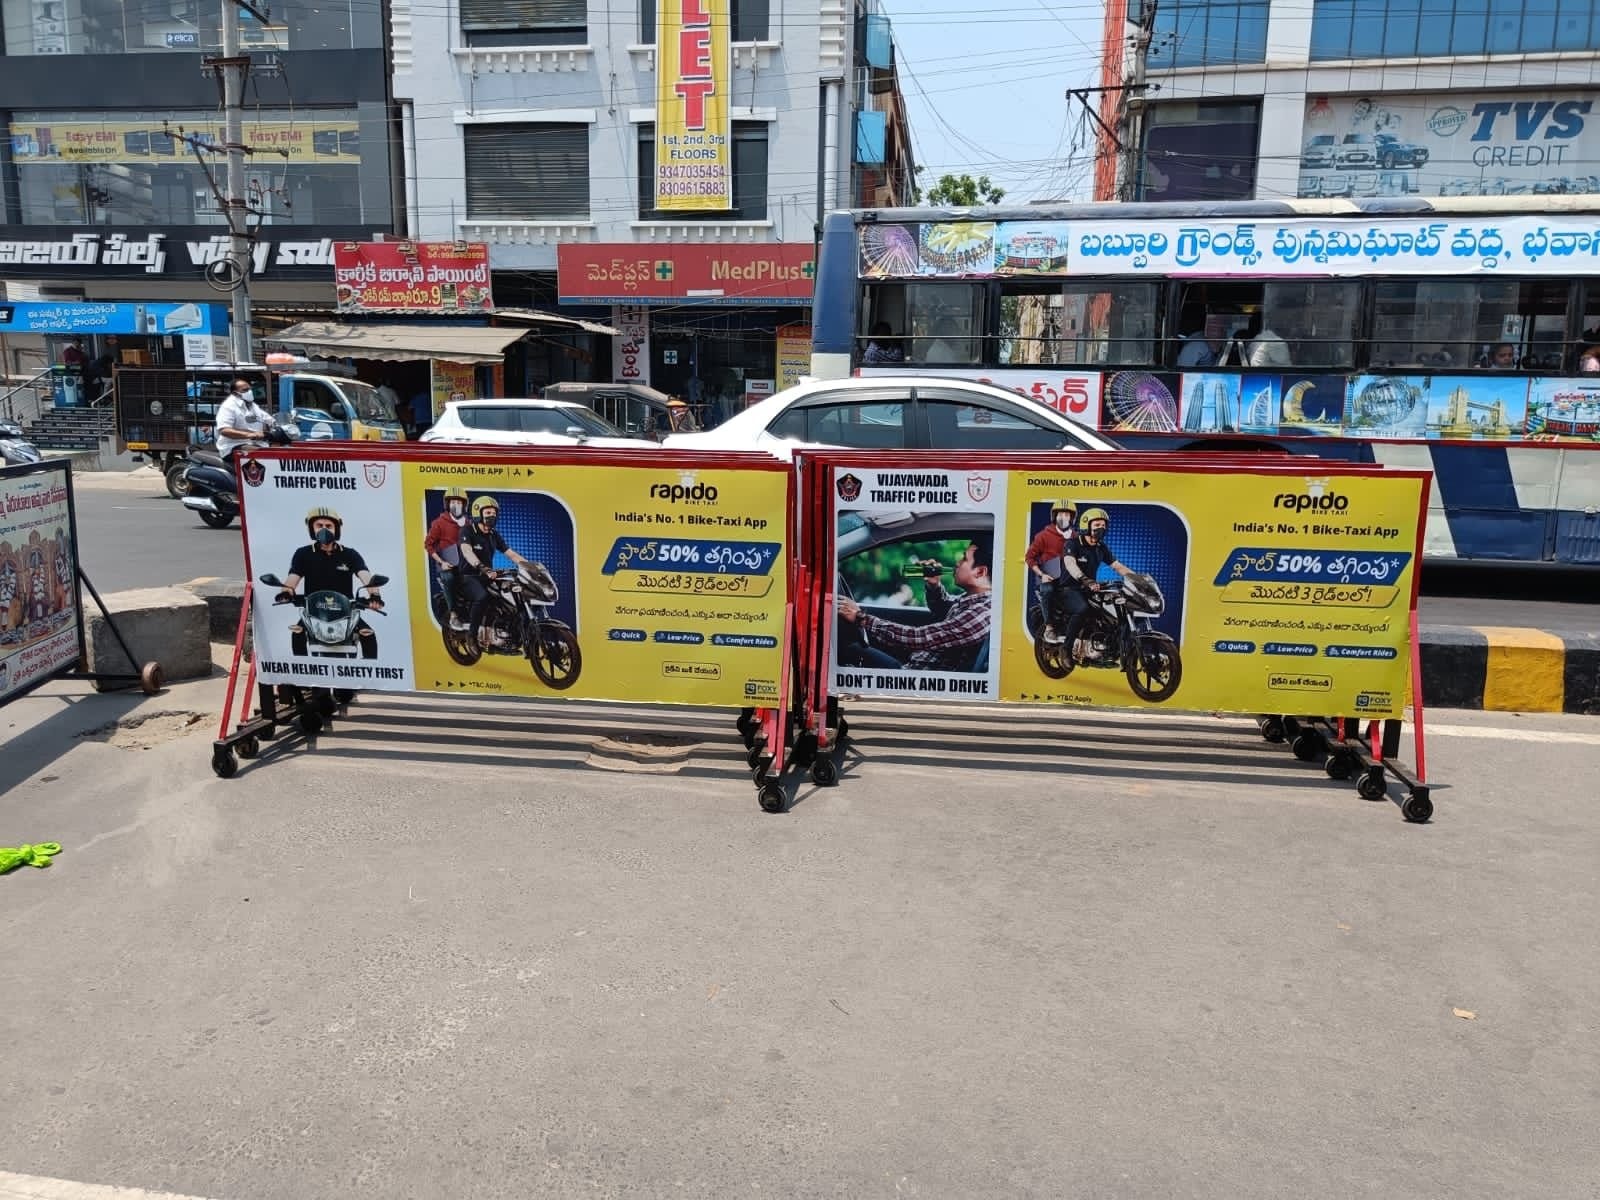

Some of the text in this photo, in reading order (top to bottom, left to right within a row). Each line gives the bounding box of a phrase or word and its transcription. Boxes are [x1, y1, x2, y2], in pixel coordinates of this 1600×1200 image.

[1470, 101, 1593, 142] TVS
[95, 131, 117, 142] EMI
[709, 134, 725, 145] 3rd
[670, 149, 717, 159] FLOORS
[1472, 145, 1570, 167] CREDIT
[659, 165, 725, 178] 9347035454
[659, 181, 726, 195] 8309615883
[711, 260, 800, 281] MedPlus
[279, 458, 347, 474] VIJAYAWADA
[419, 465, 504, 476] DOWNLOAD THE APP
[274, 475, 317, 489] TRAFFIC
[319, 477, 357, 491] POLICE
[877, 473, 949, 487] VIJAYAWADA
[1027, 479, 1080, 487] DOWNLOAD
[1100, 480, 1118, 488] APP
[650, 482, 718, 503] rapido
[870, 490, 915, 503] TRAFFIC
[918, 491, 958, 504] POLICE
[1273, 491, 1349, 513] rapido
[614, 512, 767, 530] India's No. 1 Bike-Taxi App
[1233, 523, 1399, 539] India's No. 1 Bike-Taxi App
[657, 544, 700, 563] 50%
[1276, 555, 1322, 573] 50%
[683, 576, 692, 589] 3
[1301, 587, 1310, 600] 3
[620, 631, 641, 639] Quick
[667, 634, 700, 642] Low-Price
[725, 636, 775, 646] Comfort Rides
[1227, 643, 1248, 652] Quick
[1276, 646, 1313, 654] Low-Price
[1340, 649, 1393, 658] Comfort Rides
[261, 661, 404, 680] WEAR HELMET SAFETY FIRST
[836, 674, 989, 693] DON'T DRINK AND DRIVE
